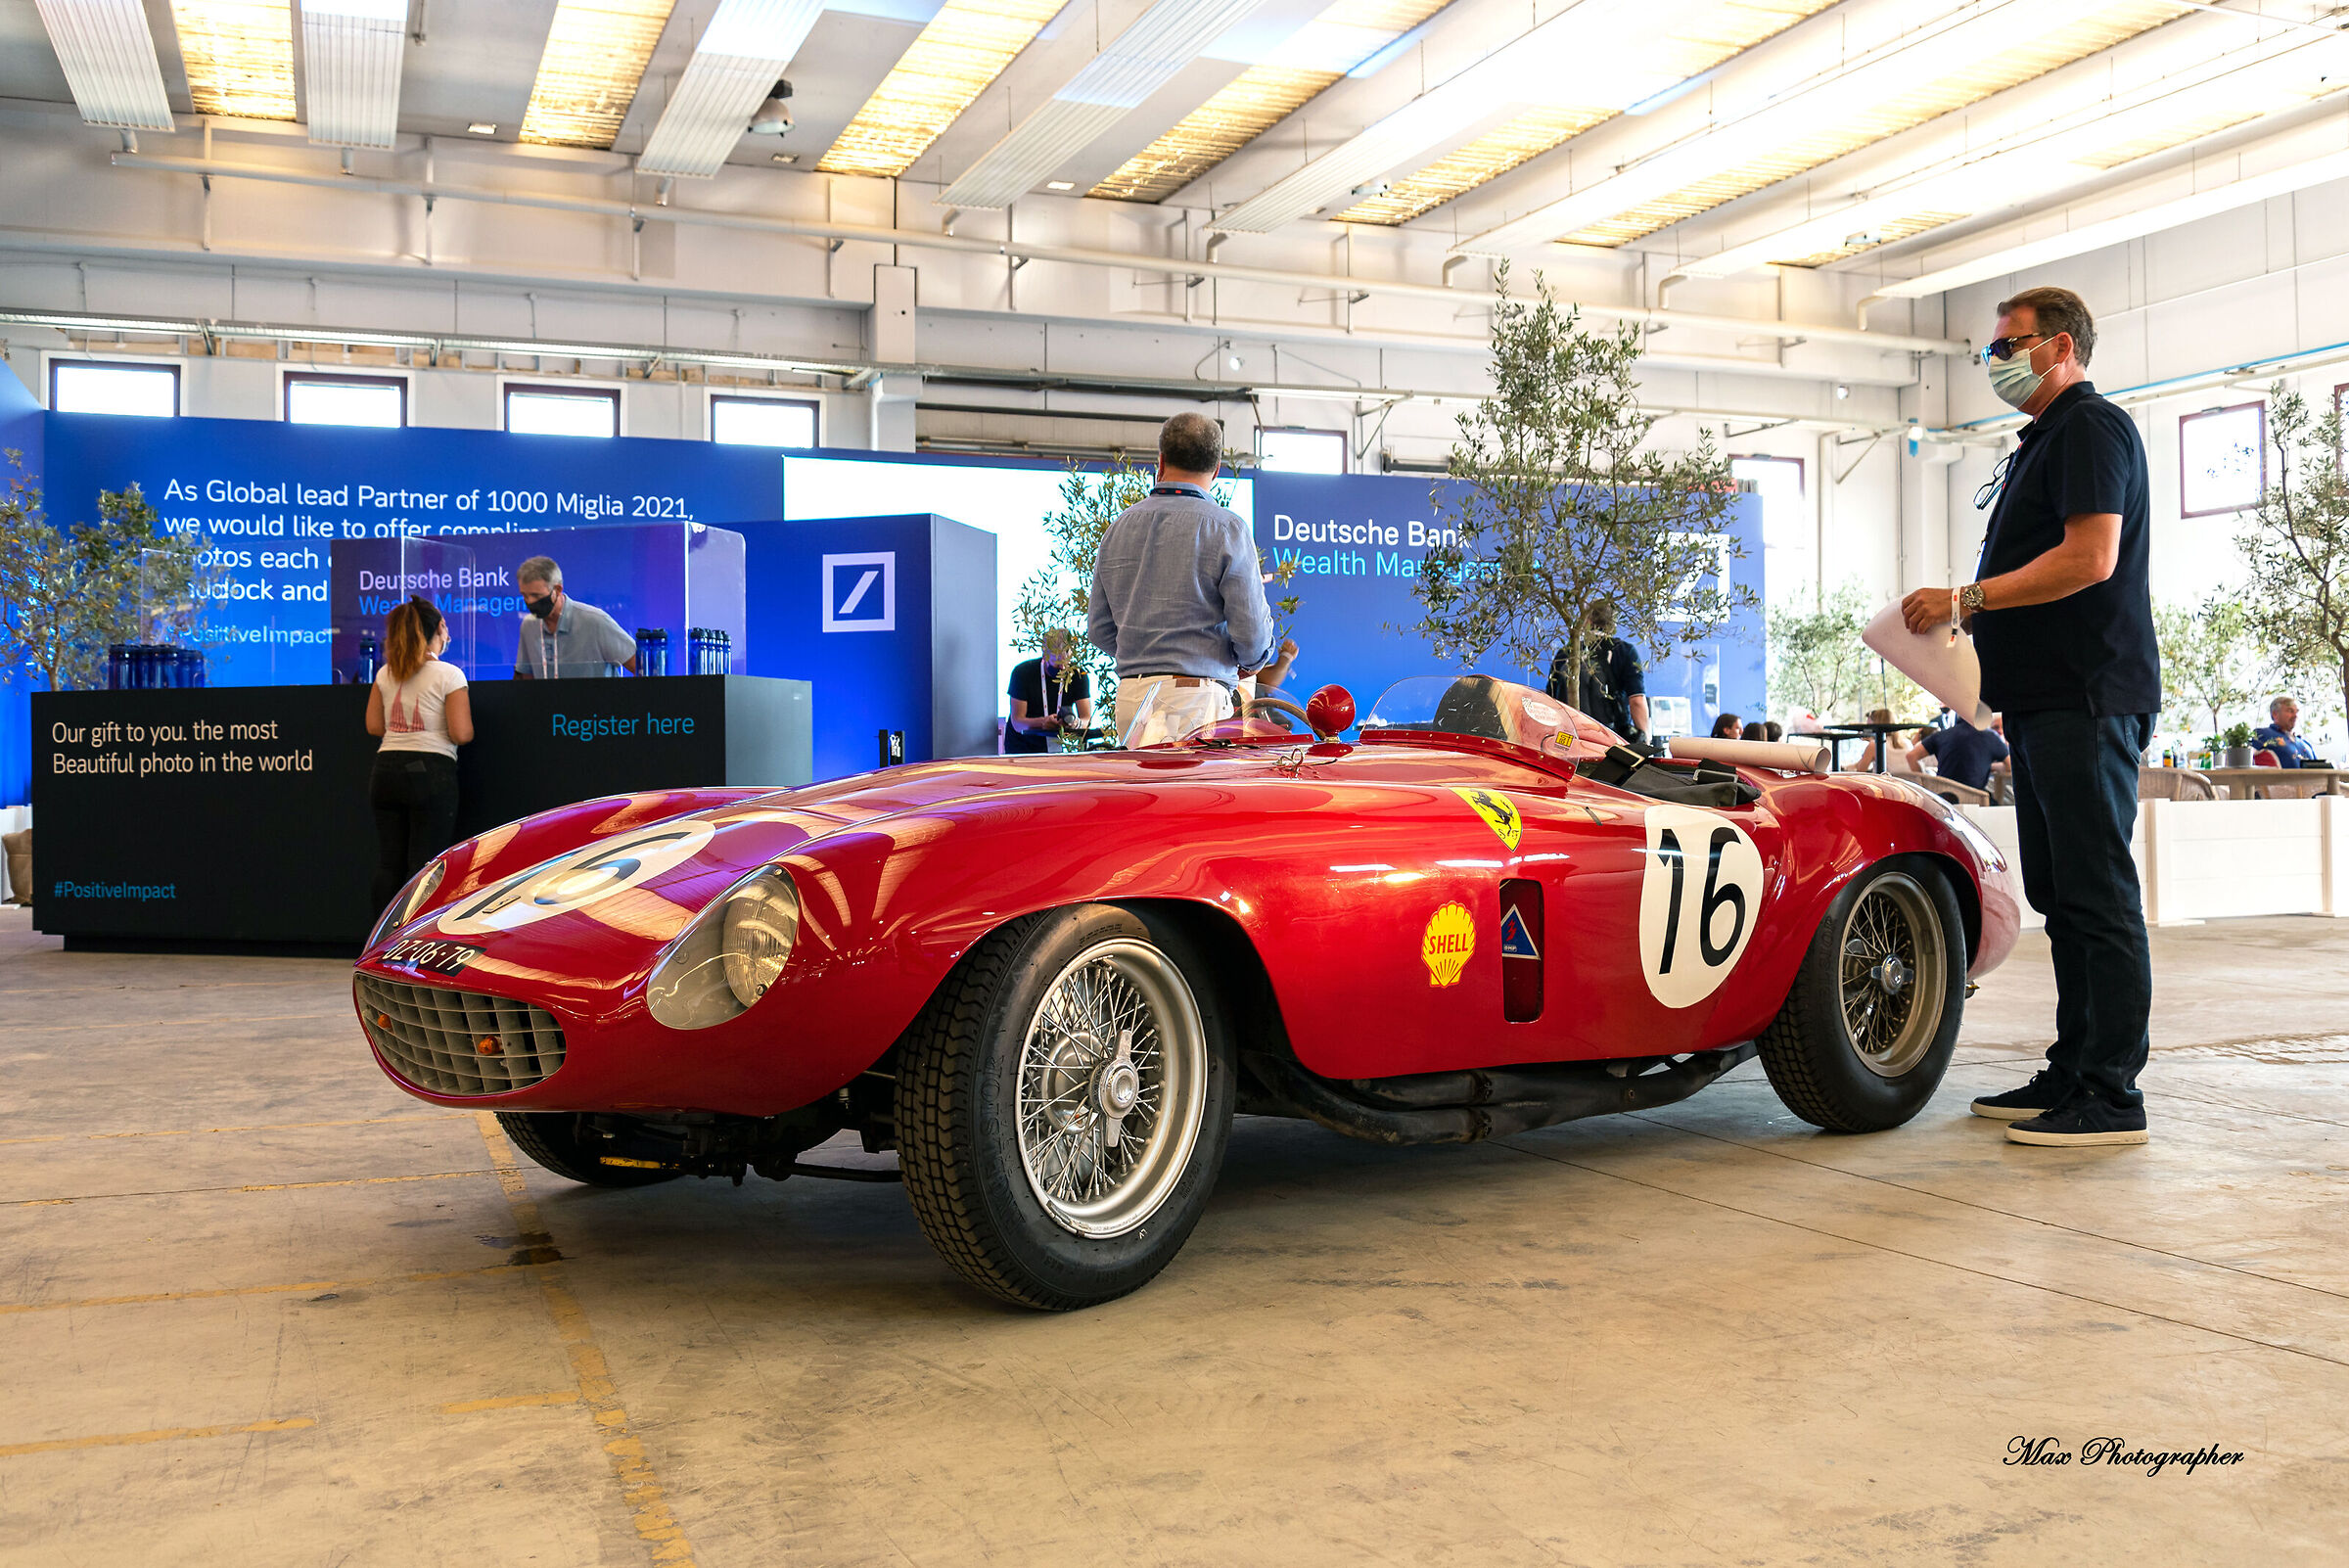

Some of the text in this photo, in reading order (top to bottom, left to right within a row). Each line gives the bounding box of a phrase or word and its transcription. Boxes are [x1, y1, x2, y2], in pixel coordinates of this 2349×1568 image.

[163, 479, 695, 521] As Global lead Partner of 1000 Miglia 2021,
[164, 518, 201, 534] we
[208, 514, 284, 536] would
[294, 516, 335, 537] like
[342, 521, 366, 537] to
[374, 518, 432, 538] offer
[1274, 514, 1473, 548] Deutsche Bank
[260, 546, 319, 570] each
[1273, 547, 1367, 576] Wealth
[282, 579, 328, 601] and
[359, 566, 510, 590] Deutsche Bank
[52, 719, 279, 748] Our gift to you. the most
[552, 712, 695, 742] Register here
[53, 750, 313, 777] Beautiful photo in the world
[54, 882, 176, 901] #PositiveImpact
[1656, 826, 1746, 975] 16
[1429, 933, 1468, 955] SHELL
